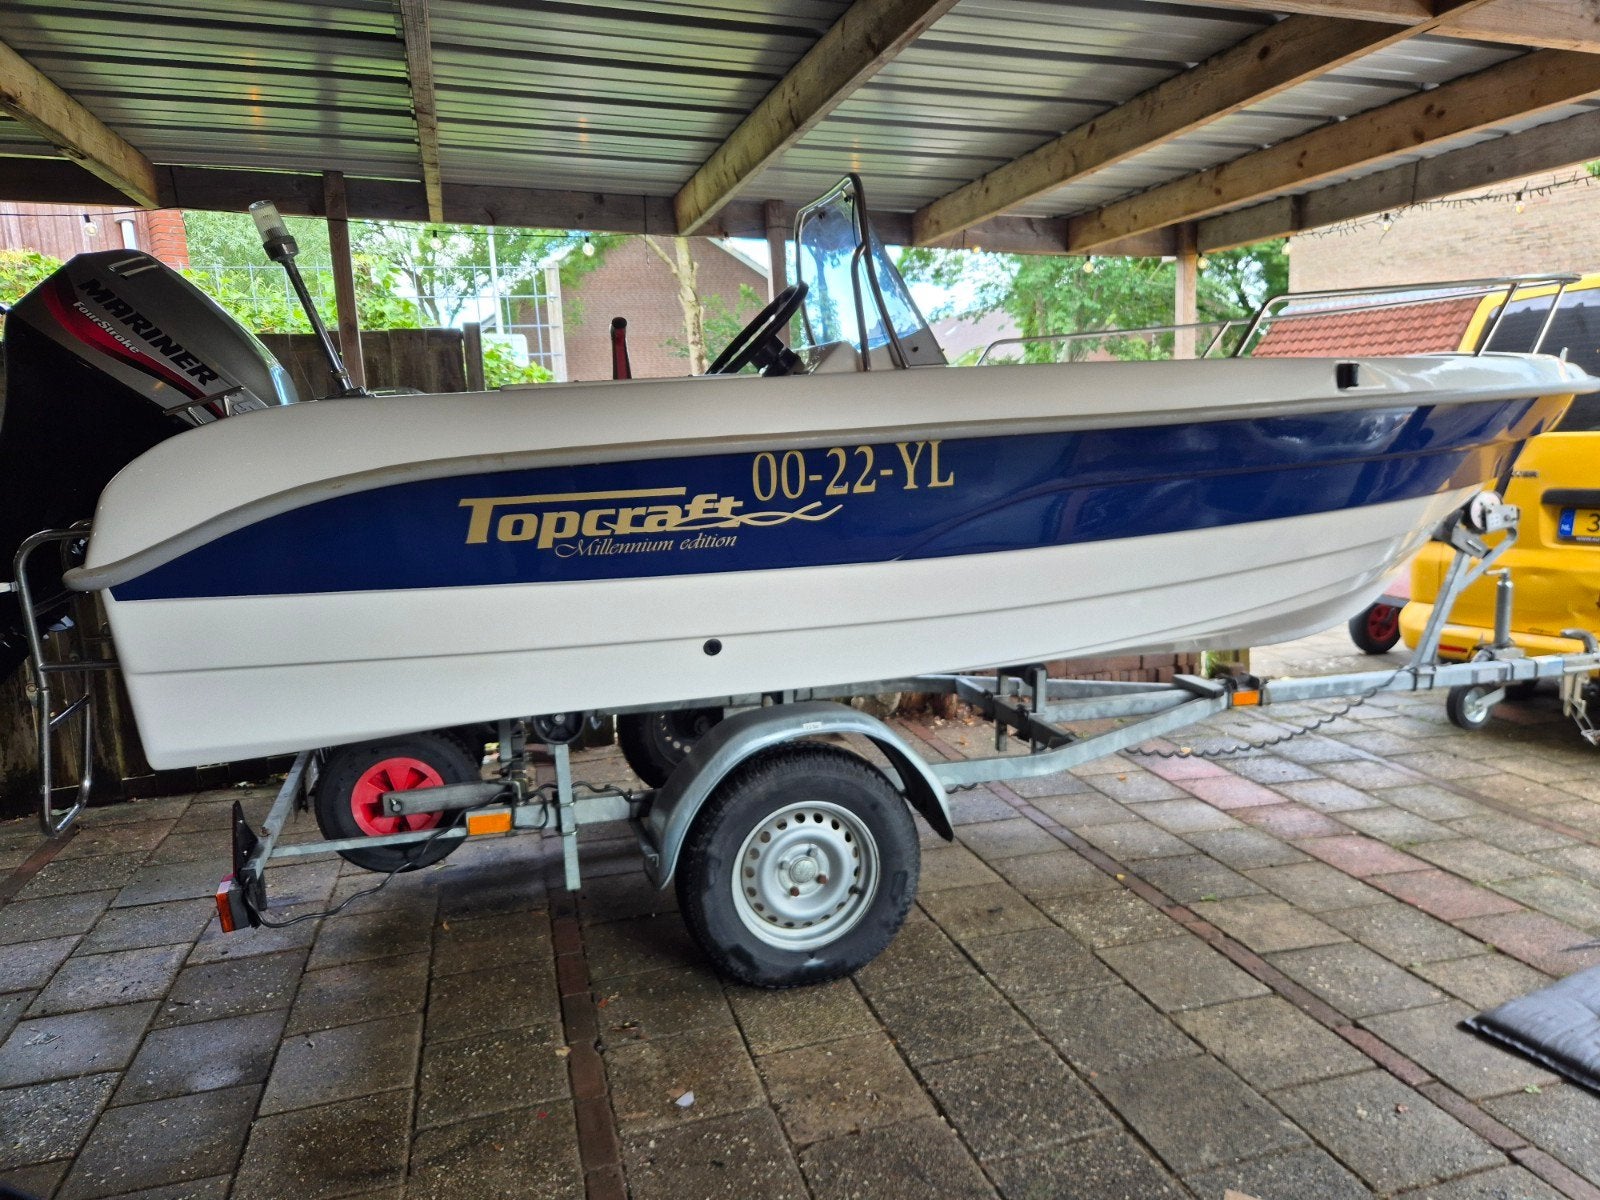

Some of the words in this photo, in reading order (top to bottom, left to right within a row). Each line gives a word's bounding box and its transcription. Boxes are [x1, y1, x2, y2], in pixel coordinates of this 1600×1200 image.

[72, 301, 140, 354] FourStroke
[77, 278, 219, 387] MARINER
[752, 440, 955, 501] 00-22-YL
[458, 486, 744, 549] Topcraft
[554, 537, 673, 558] Millennium
[680, 532, 738, 551] edition
